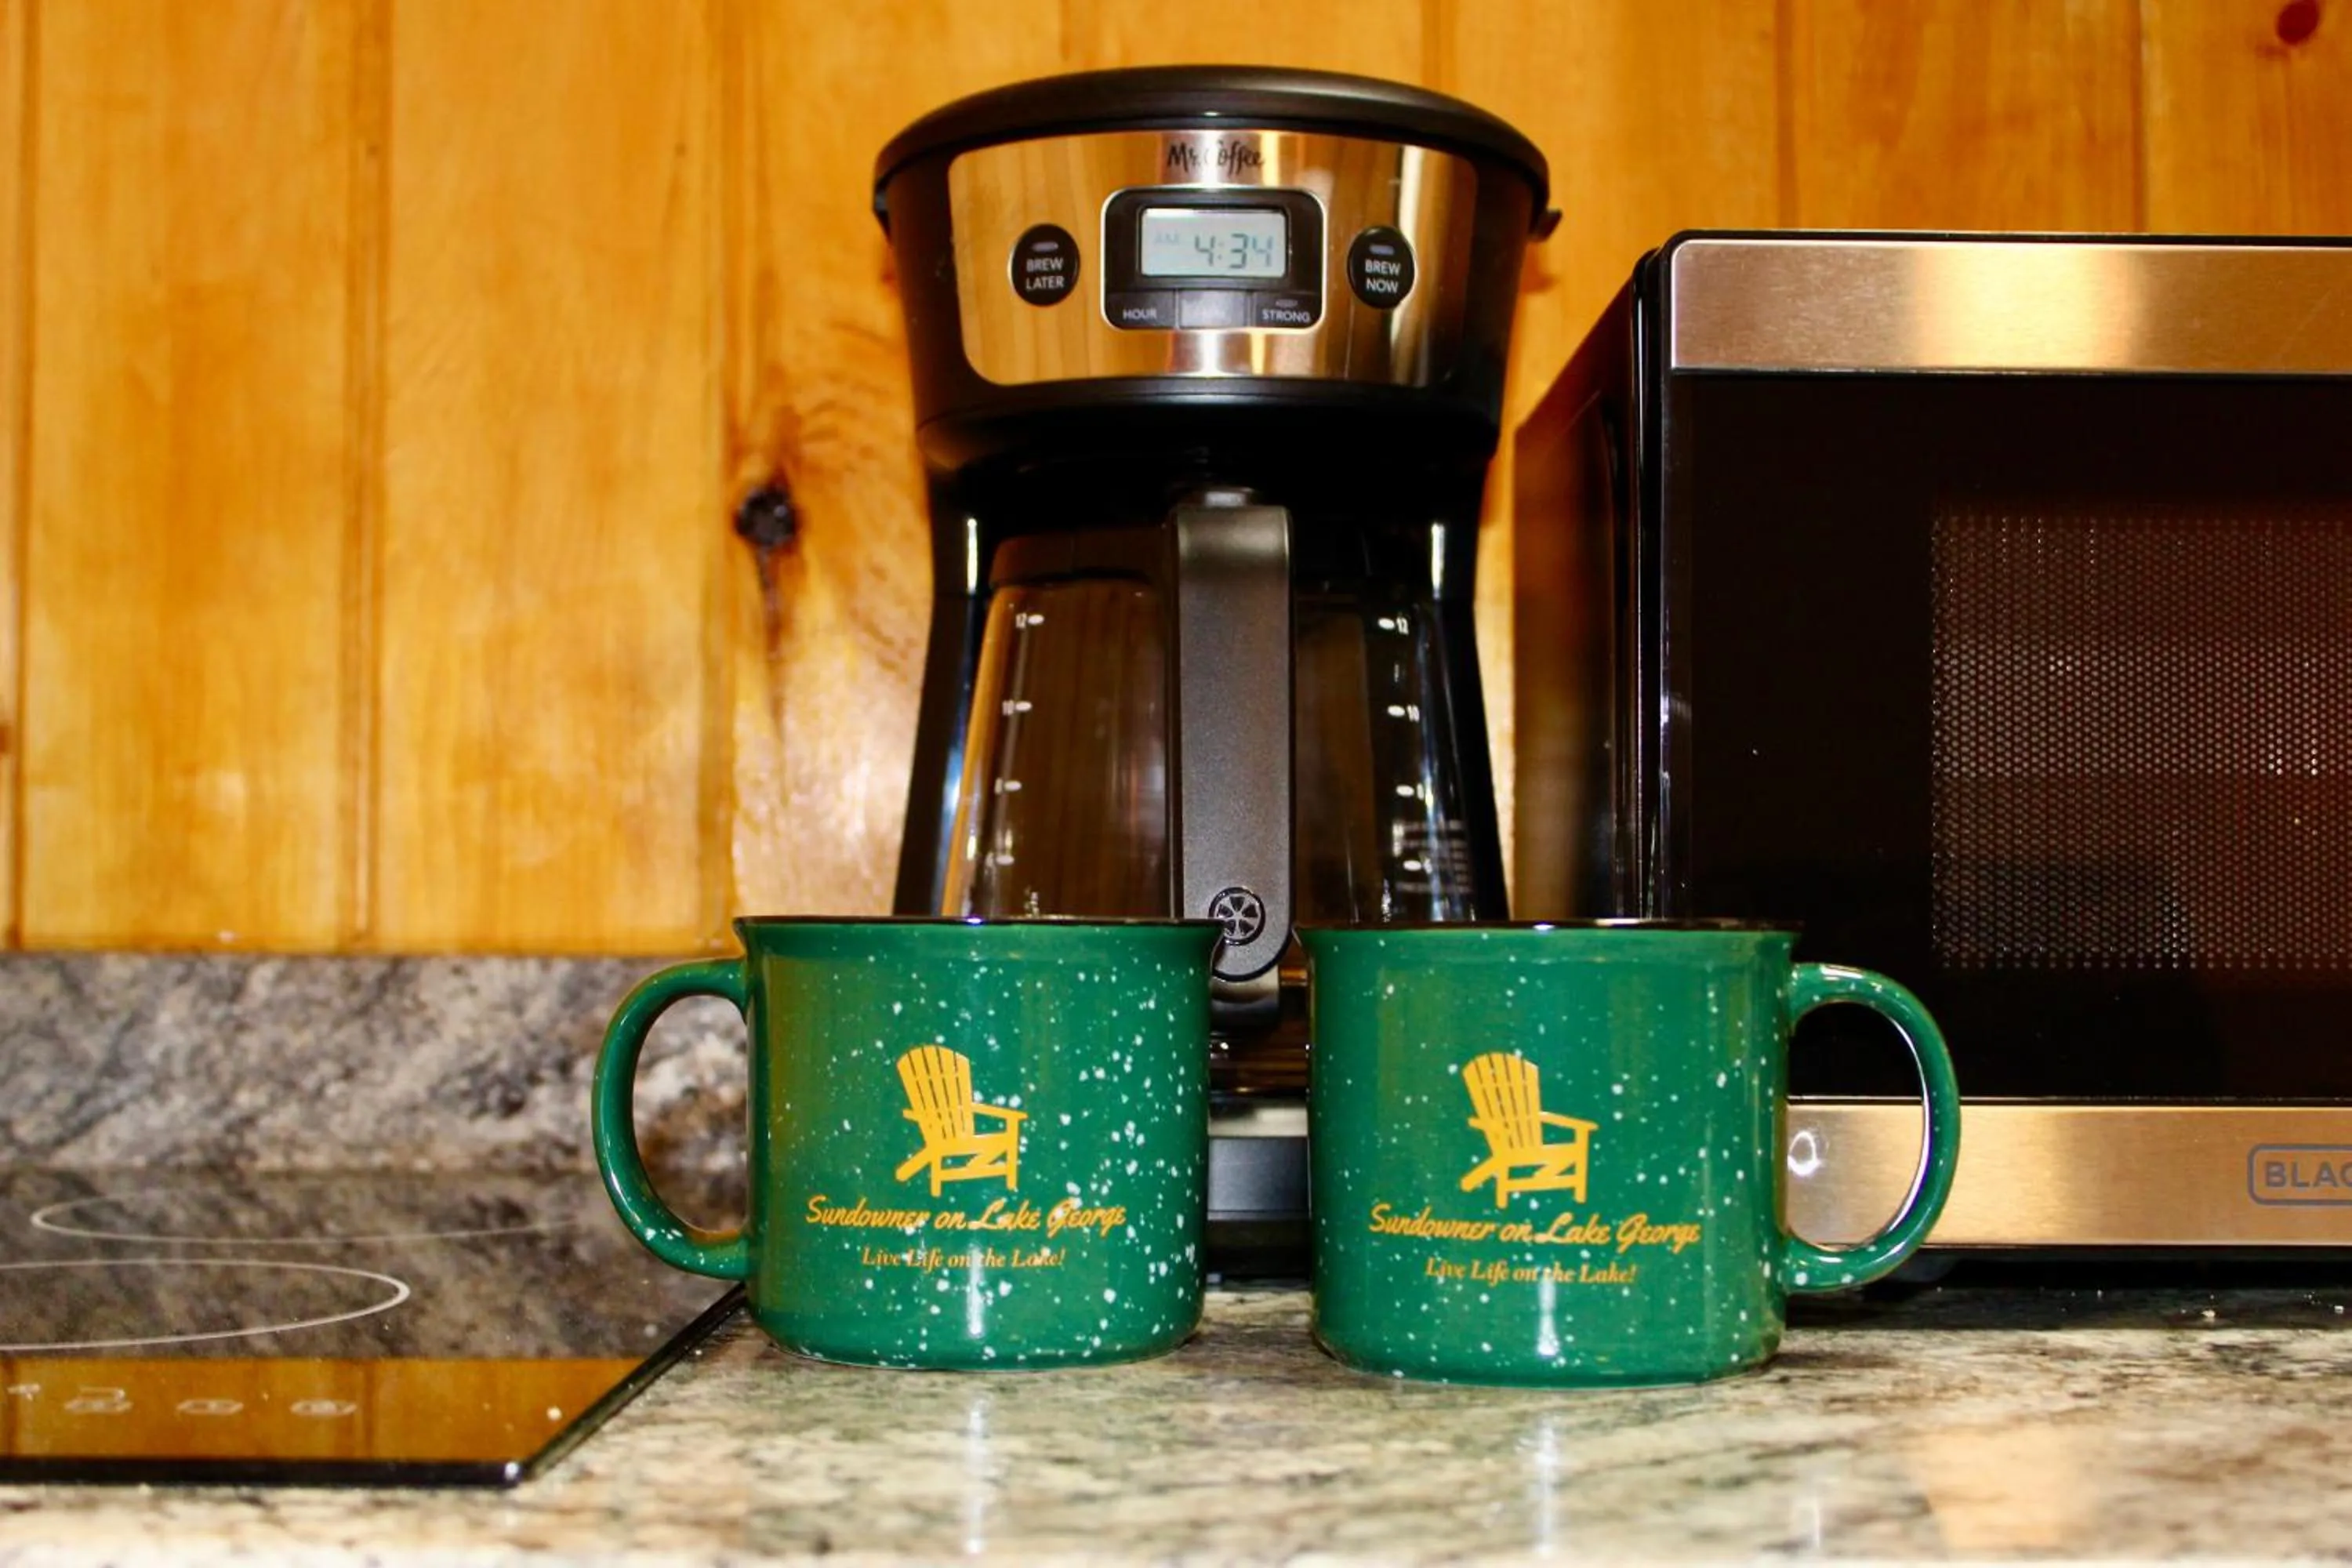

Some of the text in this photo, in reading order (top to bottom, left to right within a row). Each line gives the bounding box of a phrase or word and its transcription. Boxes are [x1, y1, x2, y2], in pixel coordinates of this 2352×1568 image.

[1195, 233, 1273, 269] 4:34
[1025, 256, 1064, 273] BREW
[1365, 259, 1401, 276] BREW
[1025, 275, 1065, 291] LATER
[1366, 278, 1399, 293] NOW
[1122, 308, 1157, 320] HOUR
[1262, 309, 1310, 323] STRONG
[805, 1194, 1126, 1239] Sundowner on Lake George
[1369, 1203, 1700, 1254] Sundowner on Lake George
[862, 1248, 900, 1266] Live
[906, 1249, 942, 1273] Life
[947, 1256, 971, 1266] on
[1011, 1248, 1067, 1268] Lake!
[1425, 1257, 1637, 1287] Live Life on the Lake!
